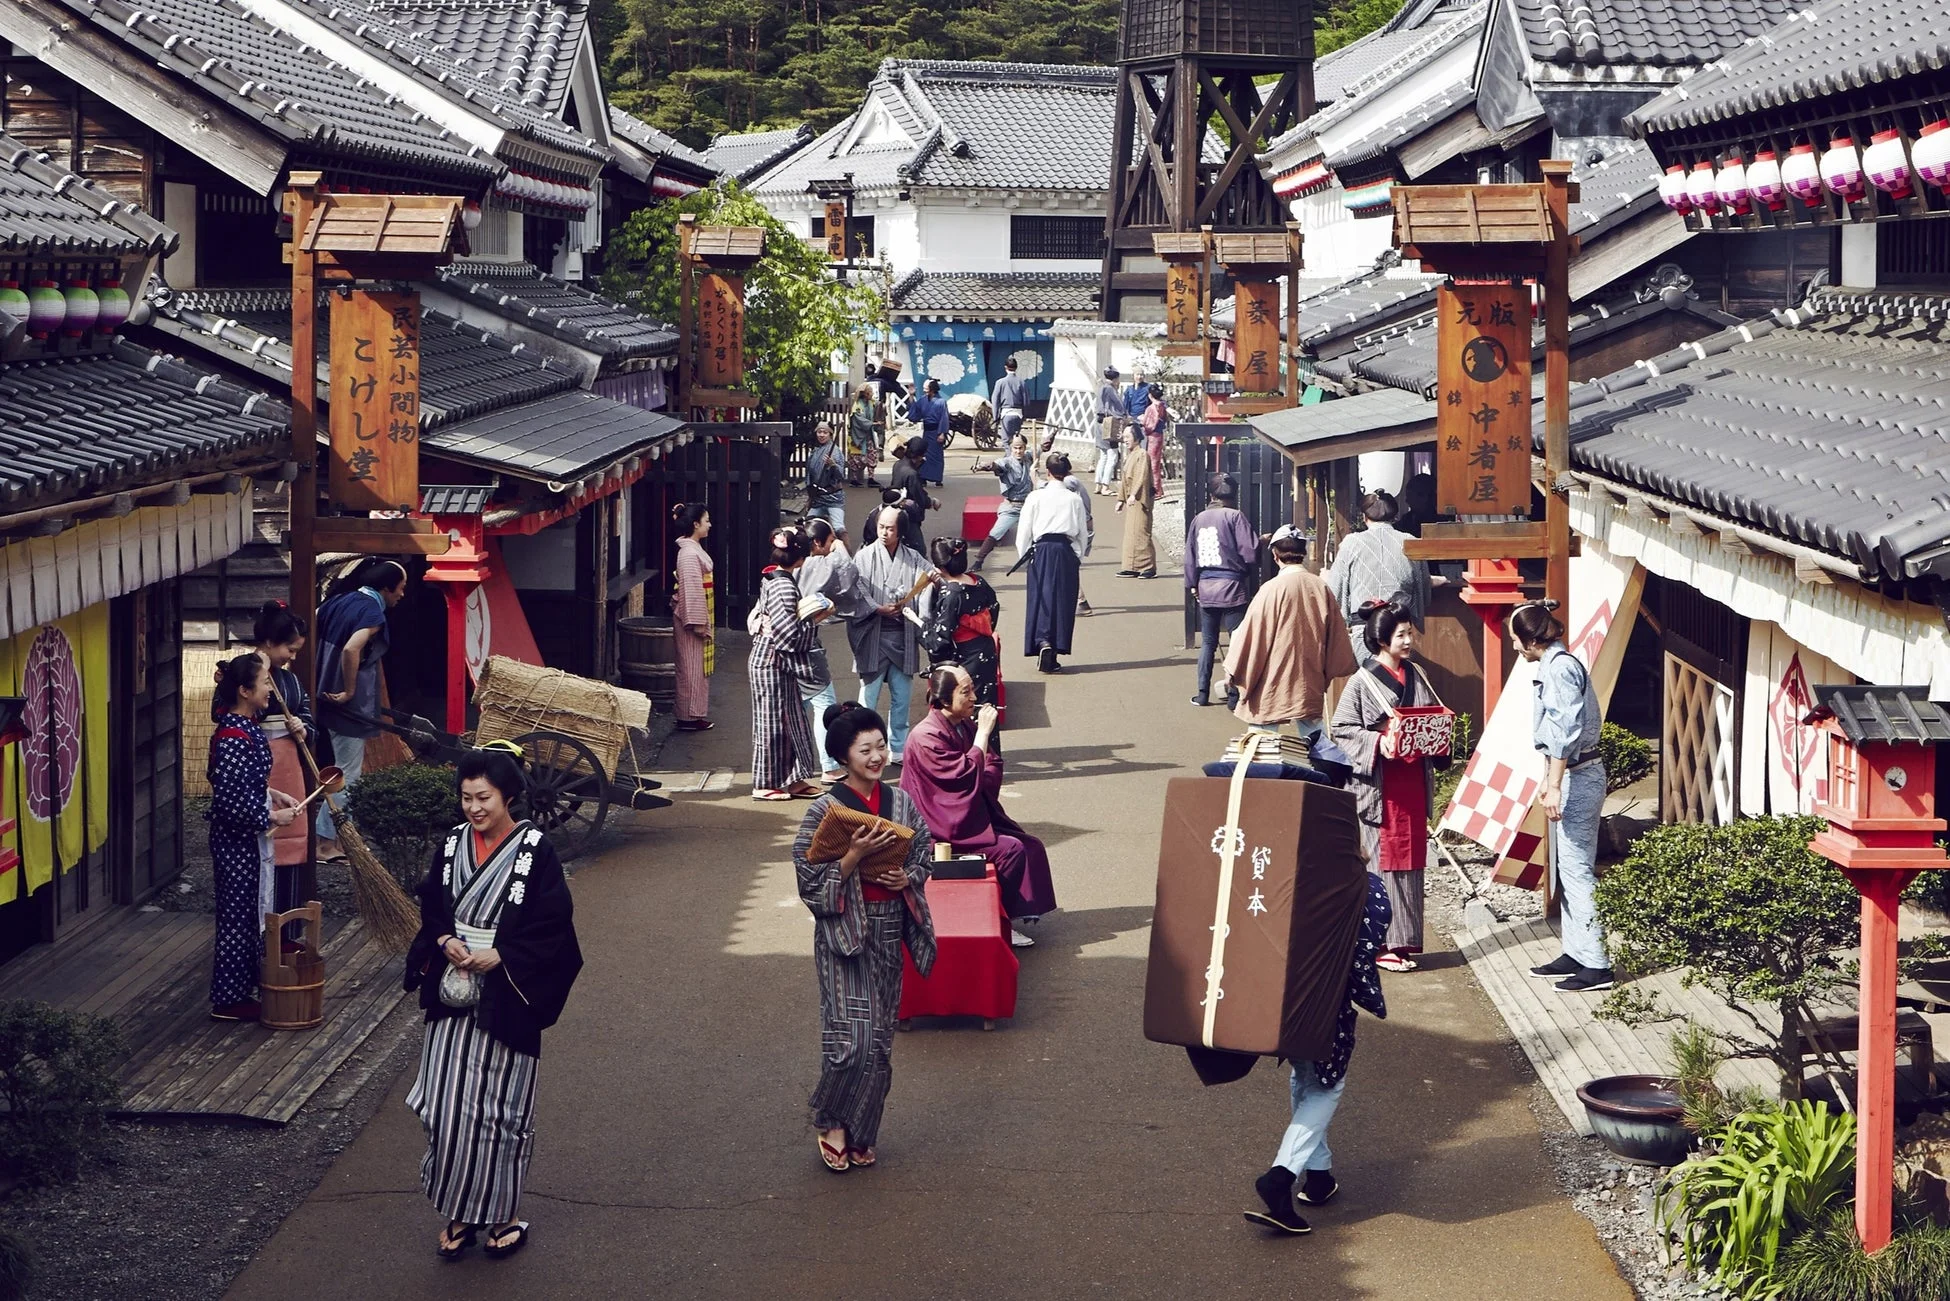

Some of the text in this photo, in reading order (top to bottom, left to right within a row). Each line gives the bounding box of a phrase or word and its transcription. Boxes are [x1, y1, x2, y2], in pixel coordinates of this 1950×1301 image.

[1171, 277, 1188, 335] 鳥そば
[1242, 301, 1269, 375] 菱屋
[346, 336, 381, 482] こけし堂
[387, 307, 417, 444] 民芸小間物
[1446, 390, 1463, 451] 錦絵
[1468, 402, 1500, 503] 中者屋
[1507, 390, 1524, 451] 草紙
[1247, 846, 1272, 917] 貸本
